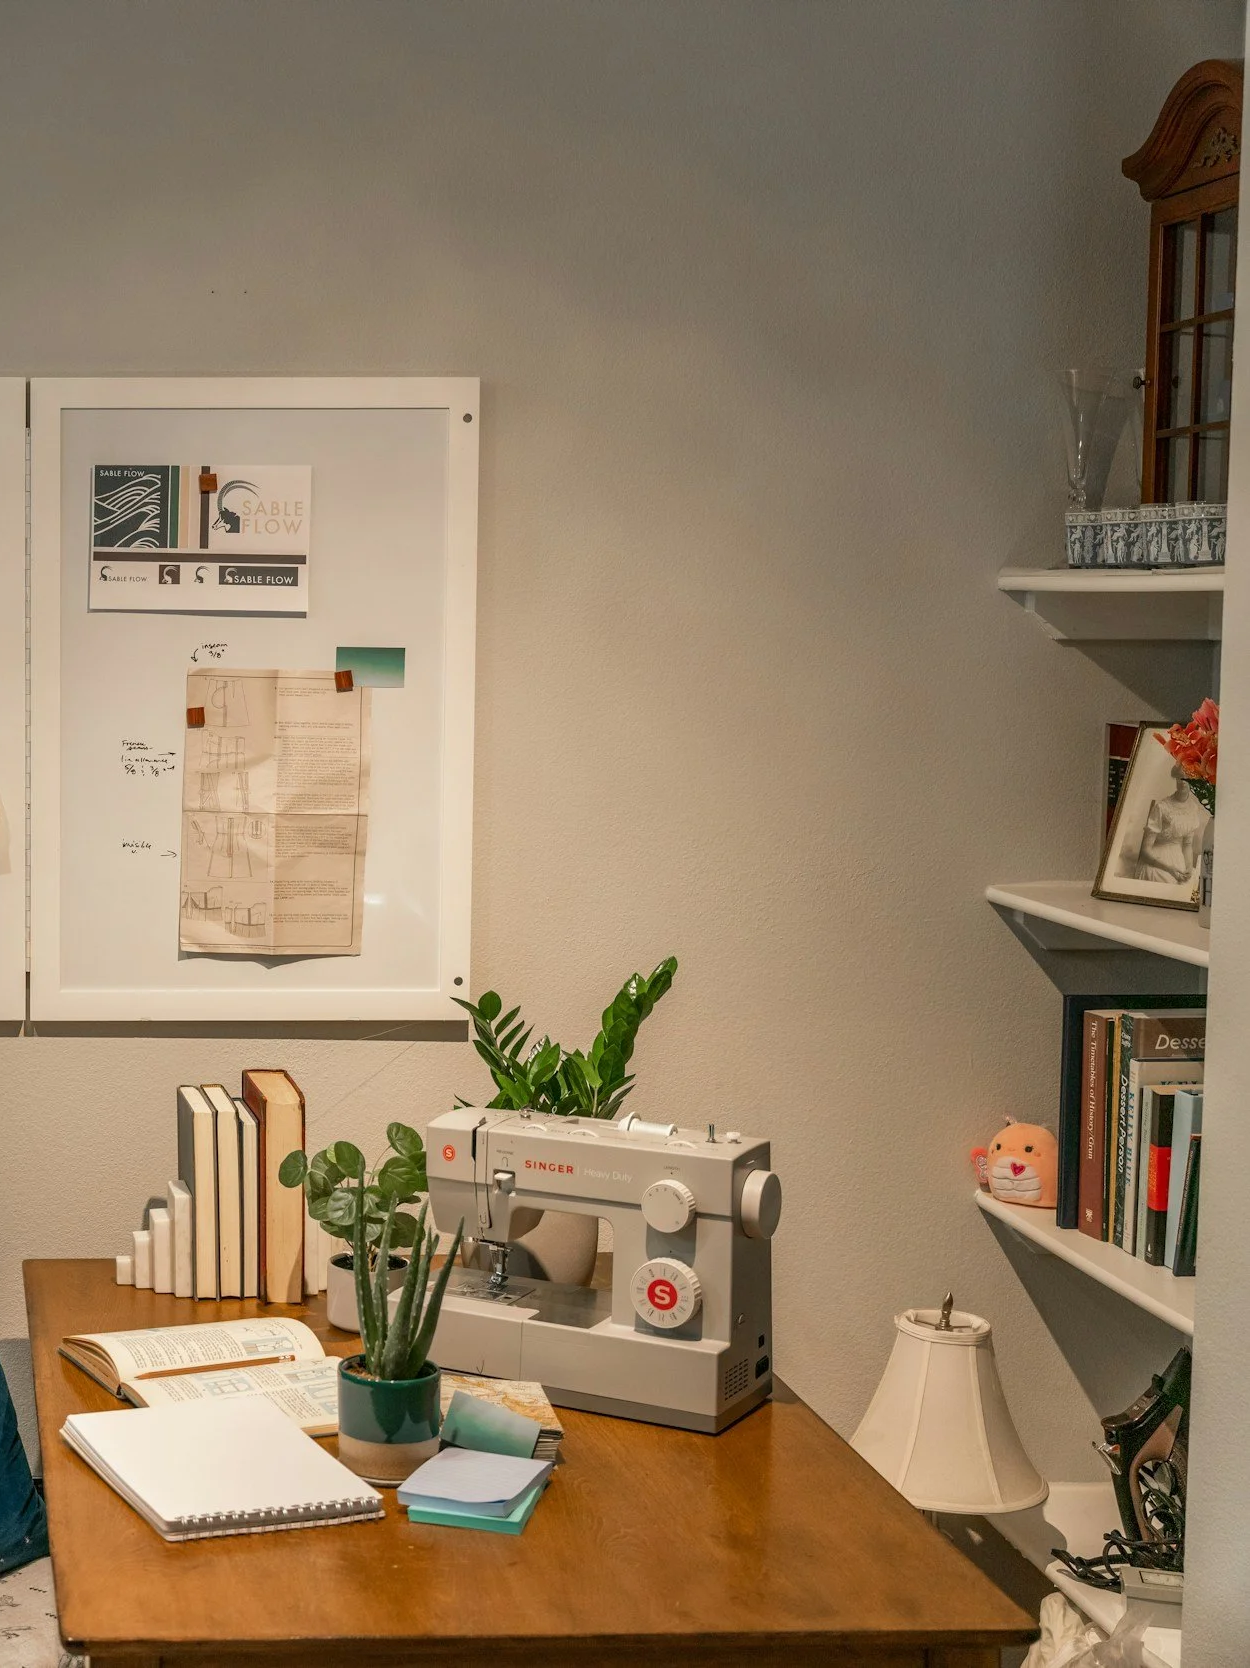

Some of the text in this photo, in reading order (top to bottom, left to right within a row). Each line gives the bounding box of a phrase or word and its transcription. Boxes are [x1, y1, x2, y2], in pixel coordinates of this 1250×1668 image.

[99, 469, 145, 477] SABLE FLOW
[242, 500, 303, 517] SABLE
[241, 519, 303, 535] FLOW
[108, 575, 127, 583] SABLE
[234, 575, 294, 585] SABLE FLOW
[1118, 1075, 1128, 1173] Dessert Person
[524, 1160, 633, 1184] SINGER Heavy Duty
[654, 1285, 671, 1305] S
